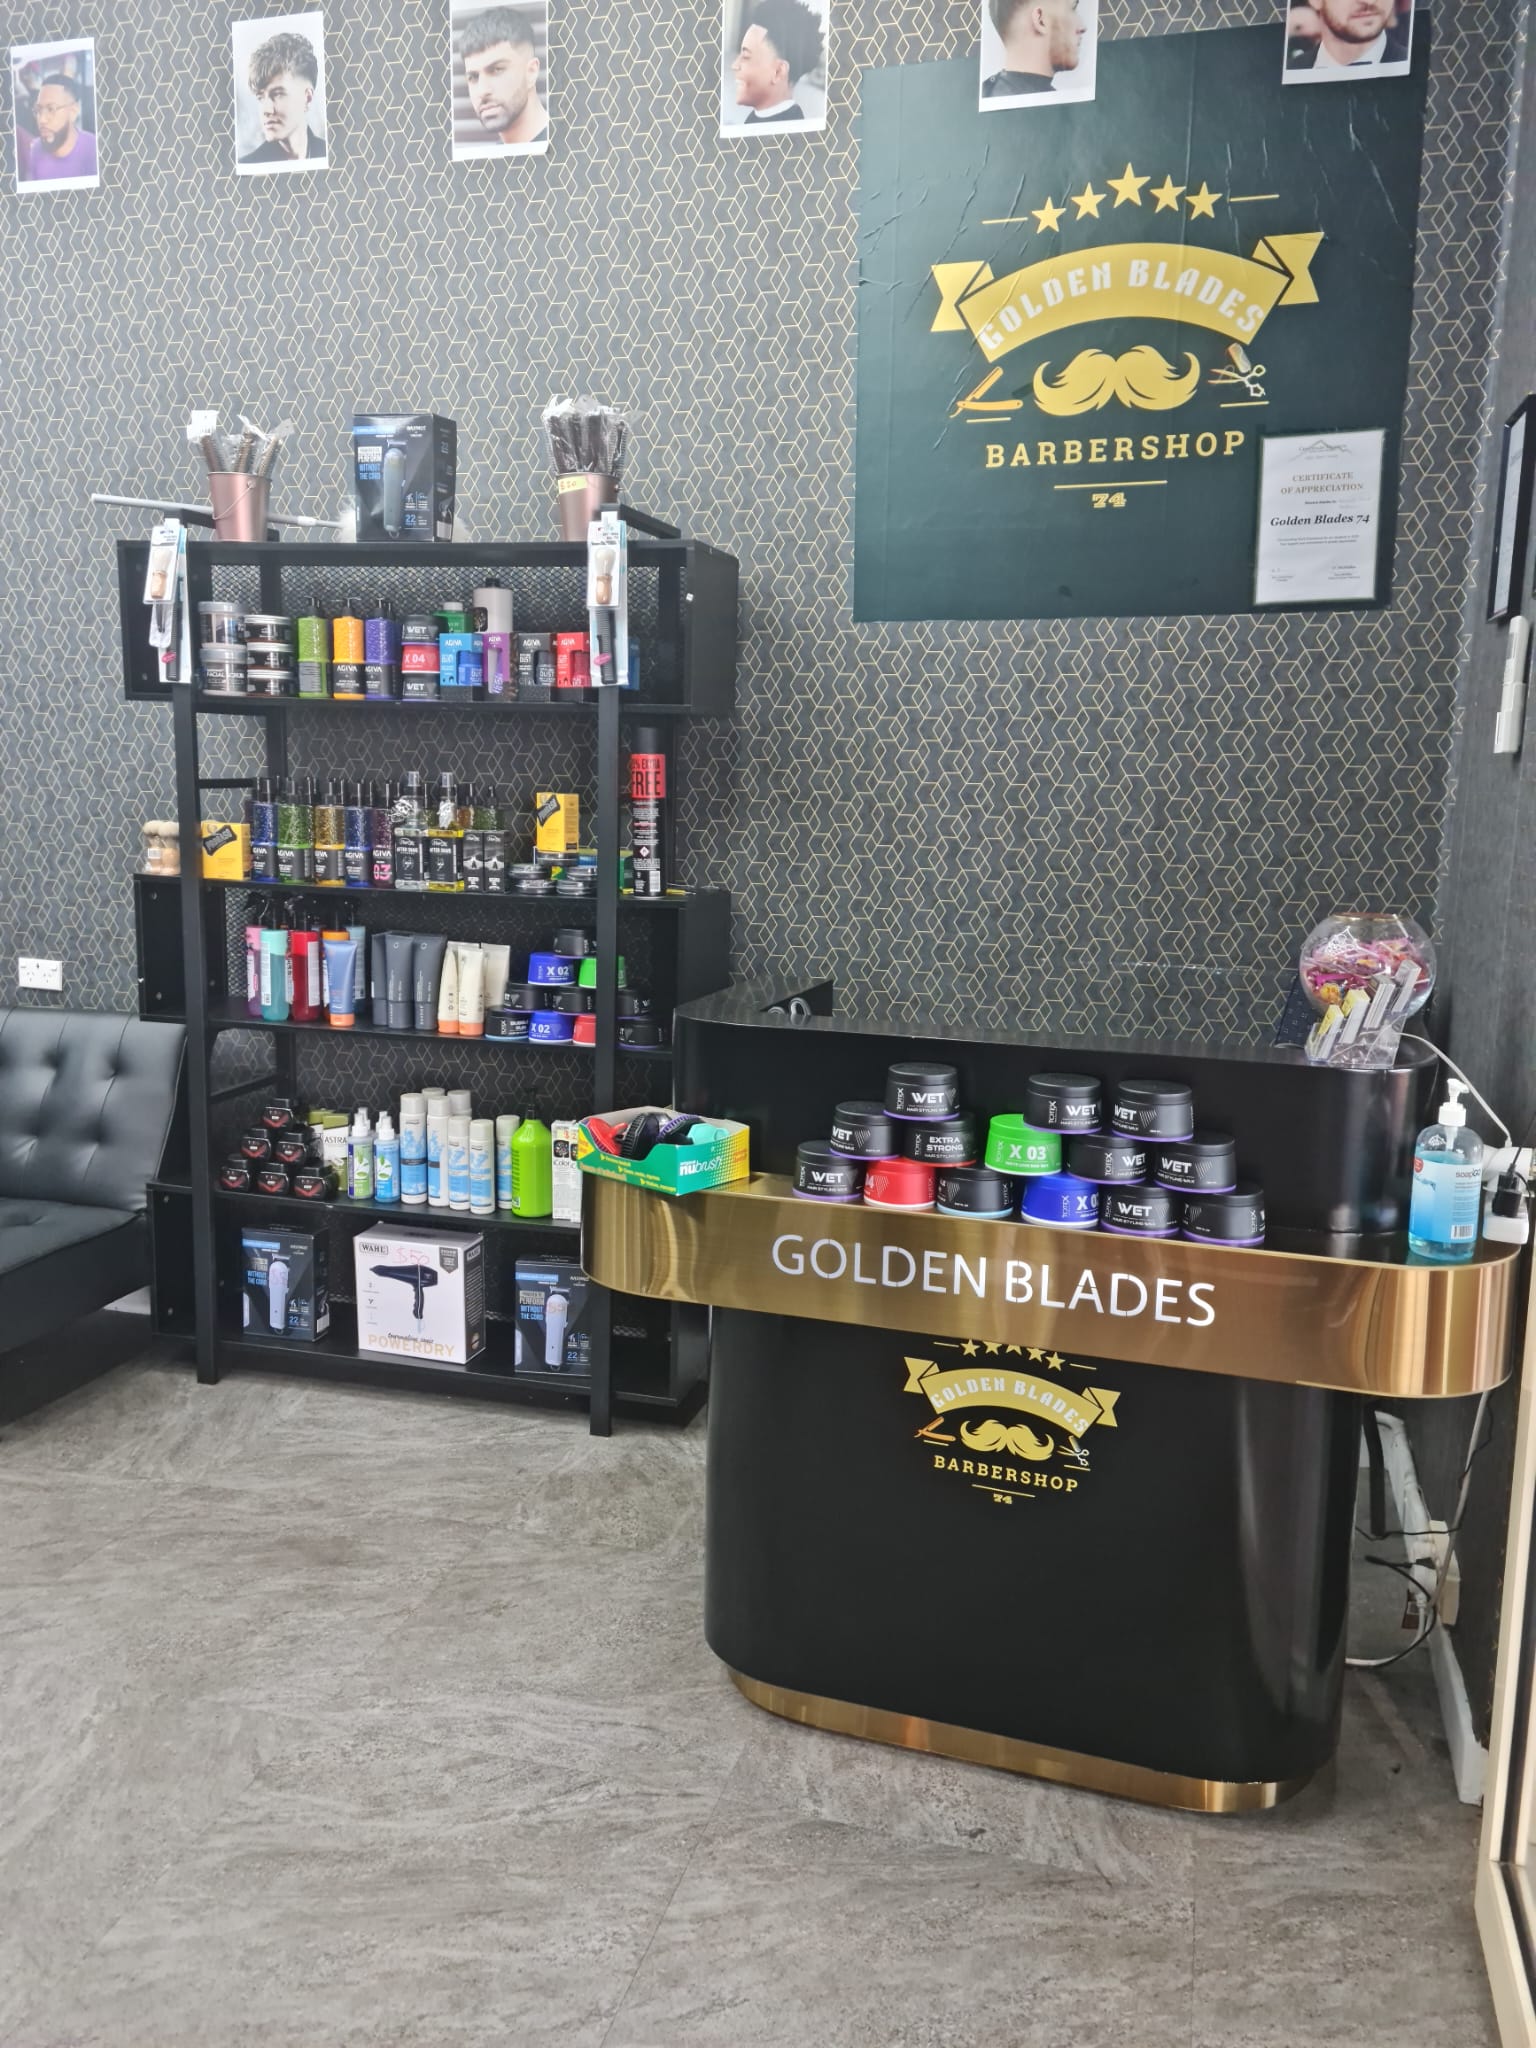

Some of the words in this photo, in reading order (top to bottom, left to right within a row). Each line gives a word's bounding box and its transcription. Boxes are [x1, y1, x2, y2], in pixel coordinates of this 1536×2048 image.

[979, 261, 1113, 351] GOLDEN
[1127, 258, 1267, 334] BLADES
[985, 429, 1246, 469] BARBERSHOP
[1292, 471, 1354, 482] CERTIFICATE
[1280, 487, 1296, 495] OF
[1296, 482, 1364, 494] APPRECIATION
[1091, 491, 1127, 510] 74
[1270, 515, 1311, 527] Golden
[1314, 513, 1354, 525] Blades
[1357, 514, 1371, 524] 74
[406, 625, 427, 634] WET
[522, 639, 541, 647] AGIVA
[336, 664, 358, 673] AGIVA
[406, 683, 425, 691] WET
[546, 966, 555, 976] X
[557, 966, 570, 976] 02
[538, 1024, 550, 1034] 02
[911, 1091, 945, 1104] WET
[1065, 1103, 1097, 1117] WET
[1114, 1103, 1137, 1121] WET
[324, 1136, 347, 1144] ASTRA
[832, 1125, 853, 1141] WET
[929, 1135, 961, 1144] EXTRA
[926, 1143, 964, 1152] STRONG
[1009, 1144, 1022, 1159] X
[1027, 1145, 1048, 1161] 03
[679, 1155, 723, 1177] nubrush
[1104, 1152, 1113, 1176] TOTEX
[1121, 1152, 1147, 1167] WET
[1161, 1157, 1193, 1174] WET
[811, 1170, 844, 1183] WET
[1076, 1195, 1089, 1211] X
[1090, 1193, 1099, 1207] 0
[1117, 1201, 1153, 1217] WET
[362, 1243, 386, 1254] WAHL
[771, 1233, 987, 1299] GOLDEN
[1004, 1259, 1217, 1327] BLADES
[367, 1333, 455, 1358] POWERDRY
[567, 1351, 578, 1359] 22
[928, 1376, 1006, 1409] GOLDEN
[1013, 1379, 1090, 1434] BLADES
[933, 1454, 1079, 1493] BARBERSHOP
[992, 1493, 1013, 1505] 74
